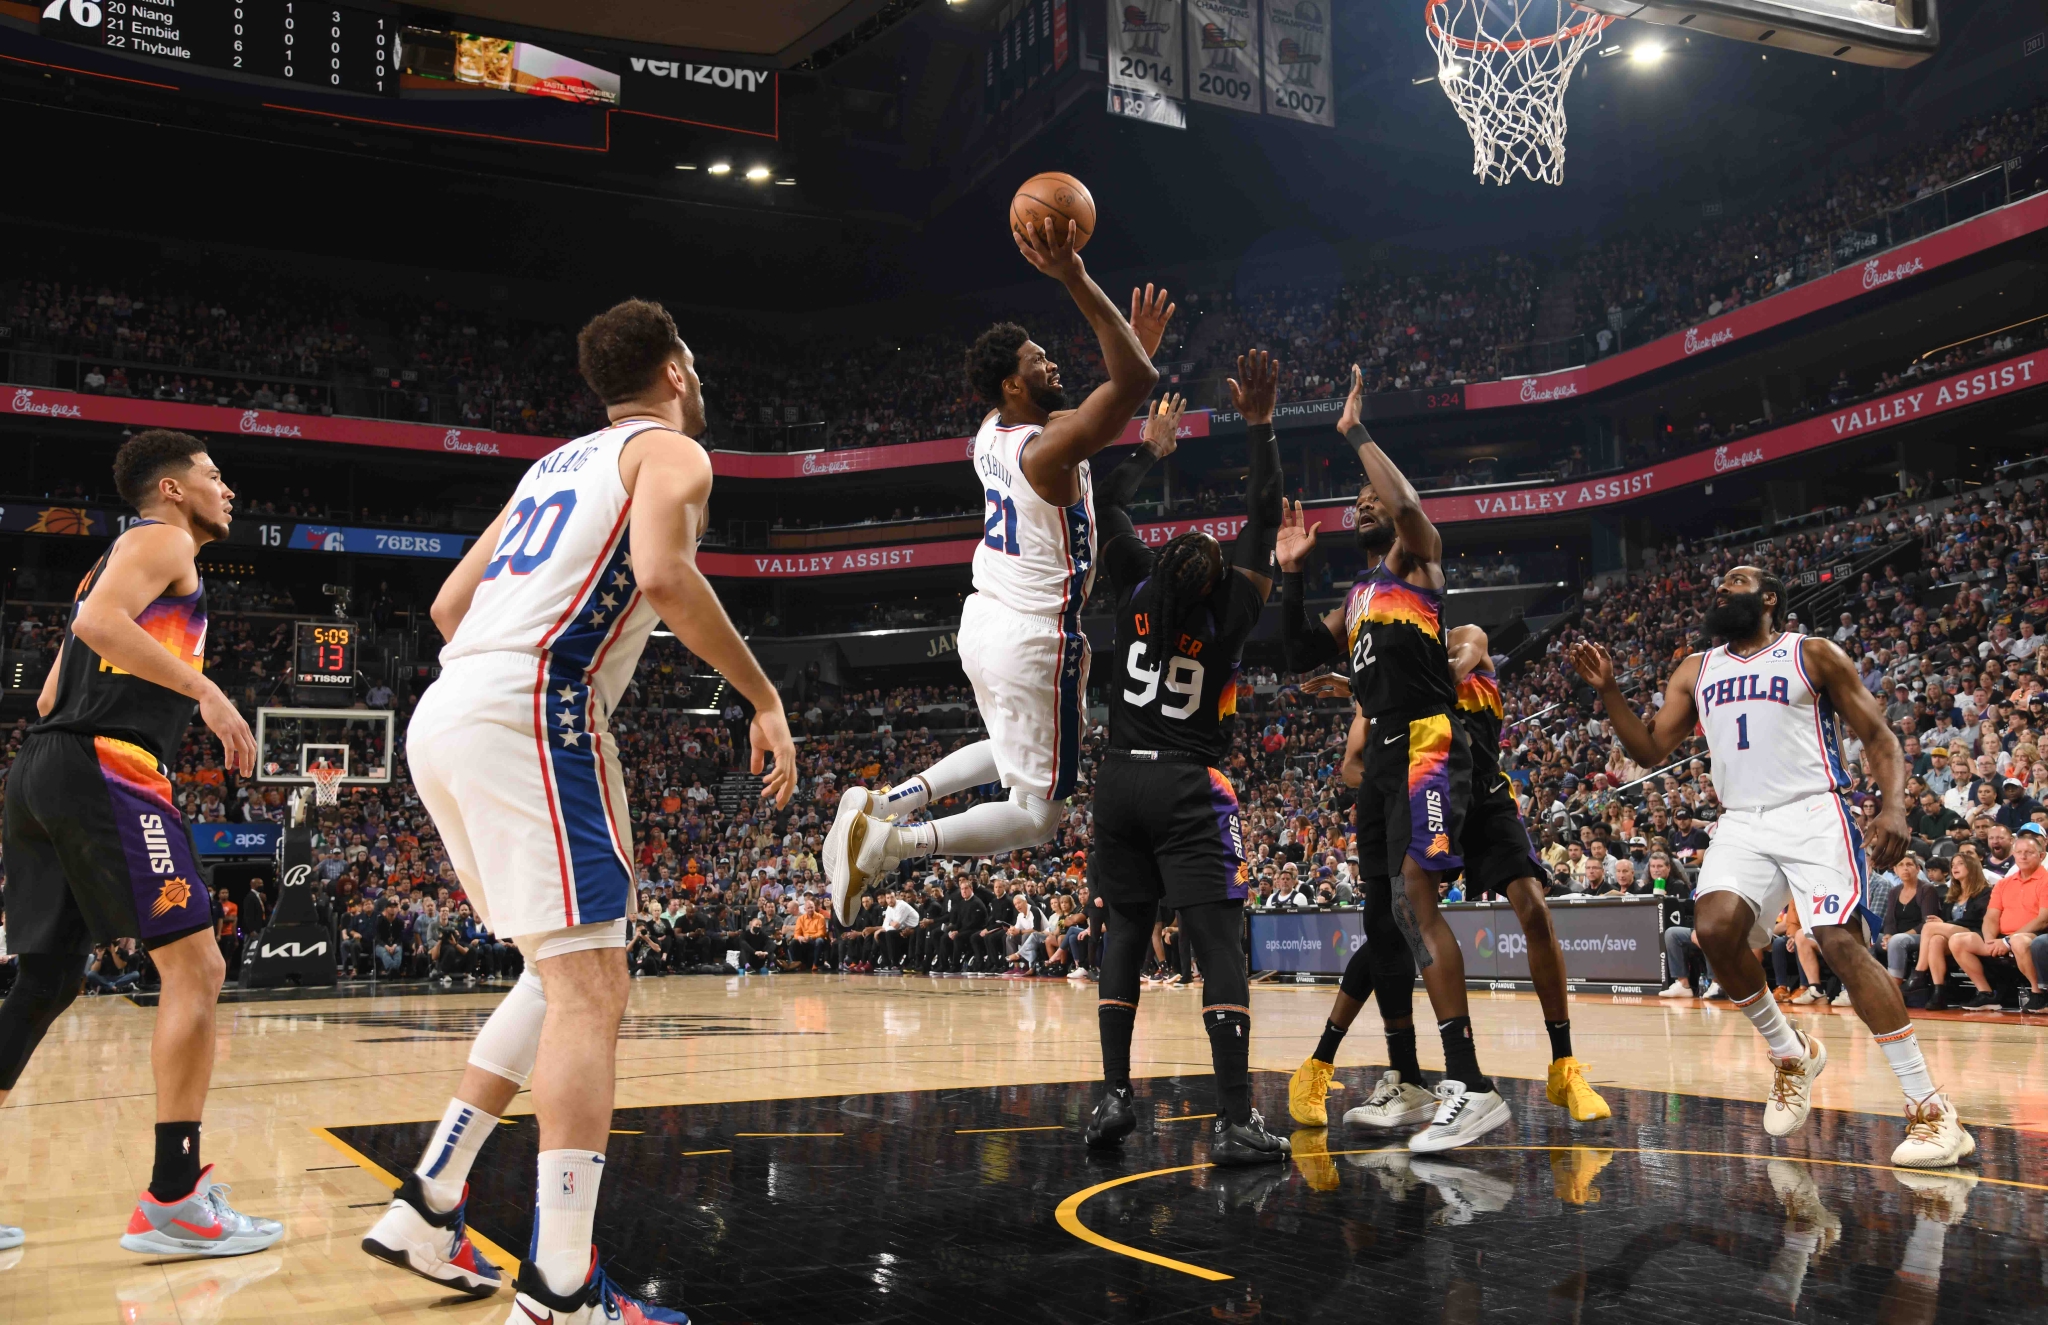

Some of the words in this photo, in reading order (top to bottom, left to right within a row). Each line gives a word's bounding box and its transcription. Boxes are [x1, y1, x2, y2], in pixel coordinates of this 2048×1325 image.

[107, 1, 126, 14] 20
[131, 5, 174, 26] Niang
[286, 2, 293, 14] 1
[332, 11, 341, 23] 3
[377, 19, 384, 30] 1
[1196, 0, 1250, 19] CHAMPIONS
[107, 17, 124, 31] 21
[131, 21, 180, 41] Embiid
[233, 40, 243, 52] 6
[286, 50, 292, 61] 1
[107, 34, 126, 48] 22
[131, 37, 191, 59] Thybulle
[233, 56, 243, 68] 2
[377, 81, 383, 92] 1
[630, 57, 756, 93] verizon
[1119, 56, 1173, 87] 2014
[542, 80, 566, 92] TASTE
[566, 84, 617, 99] RESPONSIBLY
[1199, 72, 1251, 101] 2009
[1275, 87, 1326, 115] 2007
[1426, 393, 1460, 408] 3:24
[1831, 393, 1924, 434] VALLEY
[1935, 360, 2035, 406] ASSIST
[1211, 413, 1232, 423] THE
[1233, 406, 1305, 421] PELPHIA
[1475, 490, 1567, 514] VALLEY
[1578, 472, 1654, 503] ASSIST
[259, 525, 282, 547] 15
[480, 488, 578, 583] 20
[984, 488, 1021, 557] 21
[375, 533, 442, 554] 76ERS
[755, 556, 835, 574] VALLEY
[842, 549, 915, 569] ASSIST
[314, 627, 349, 645] 5:09
[318, 644, 344, 671] 13
[1353, 632, 1377, 673] 22
[312, 674, 353, 684] TISSOT
[1123, 640, 1205, 720] 99
[1702, 673, 1790, 717] PHILA
[1735, 713, 1750, 751] 1
[1426, 789, 1444, 832] SUNS
[139, 814, 175, 874] SUNS
[235, 833, 266, 848] aps
[1812, 894, 1840, 915] 76
[261, 941, 327, 958] KIA
[1265, 936, 1322, 952] aps.com/save
[1495, 982, 1516, 990] FANDUEL
[1618, 985, 1642, 993] FANDUEL
